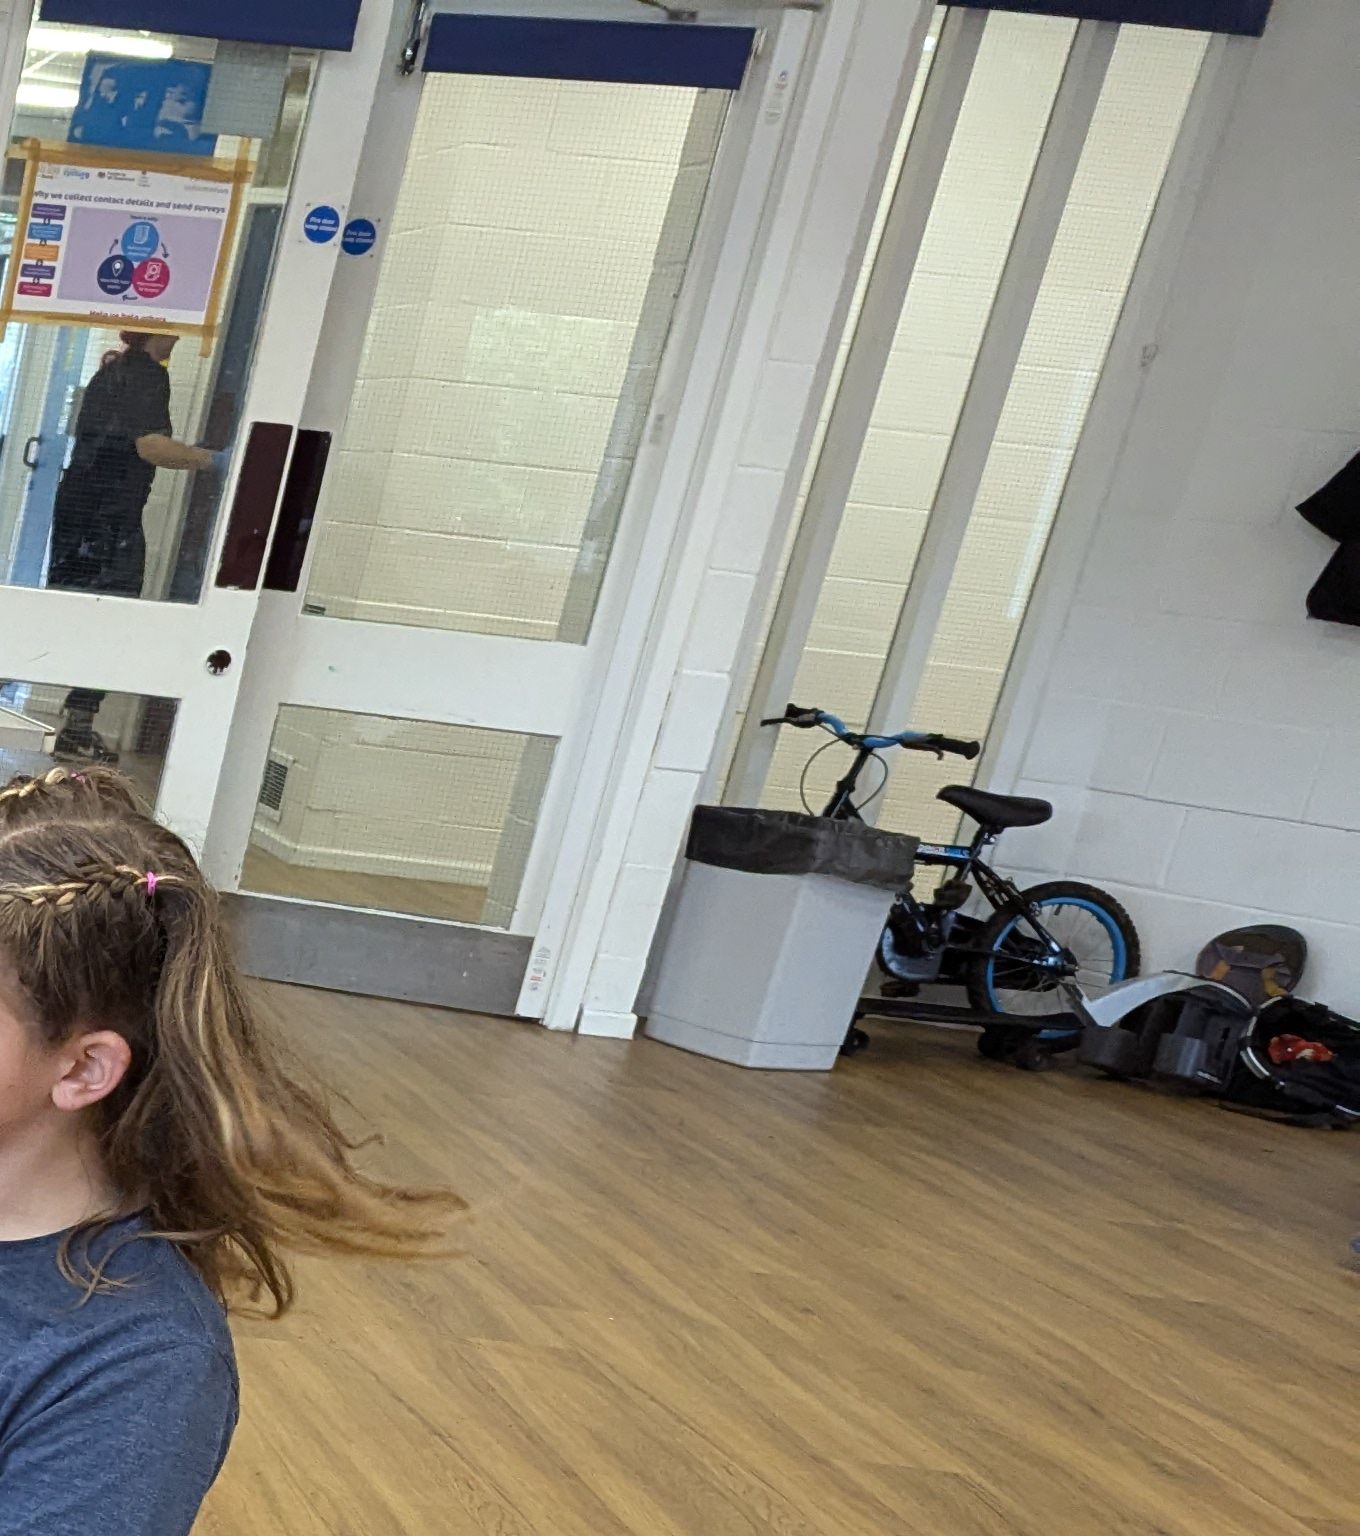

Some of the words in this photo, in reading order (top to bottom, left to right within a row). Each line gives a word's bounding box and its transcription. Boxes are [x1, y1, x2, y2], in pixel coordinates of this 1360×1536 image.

[93, 194, 125, 205] contact
[125, 197, 154, 207] details
[155, 200, 172, 209] and
[194, 204, 226, 214] surveys
